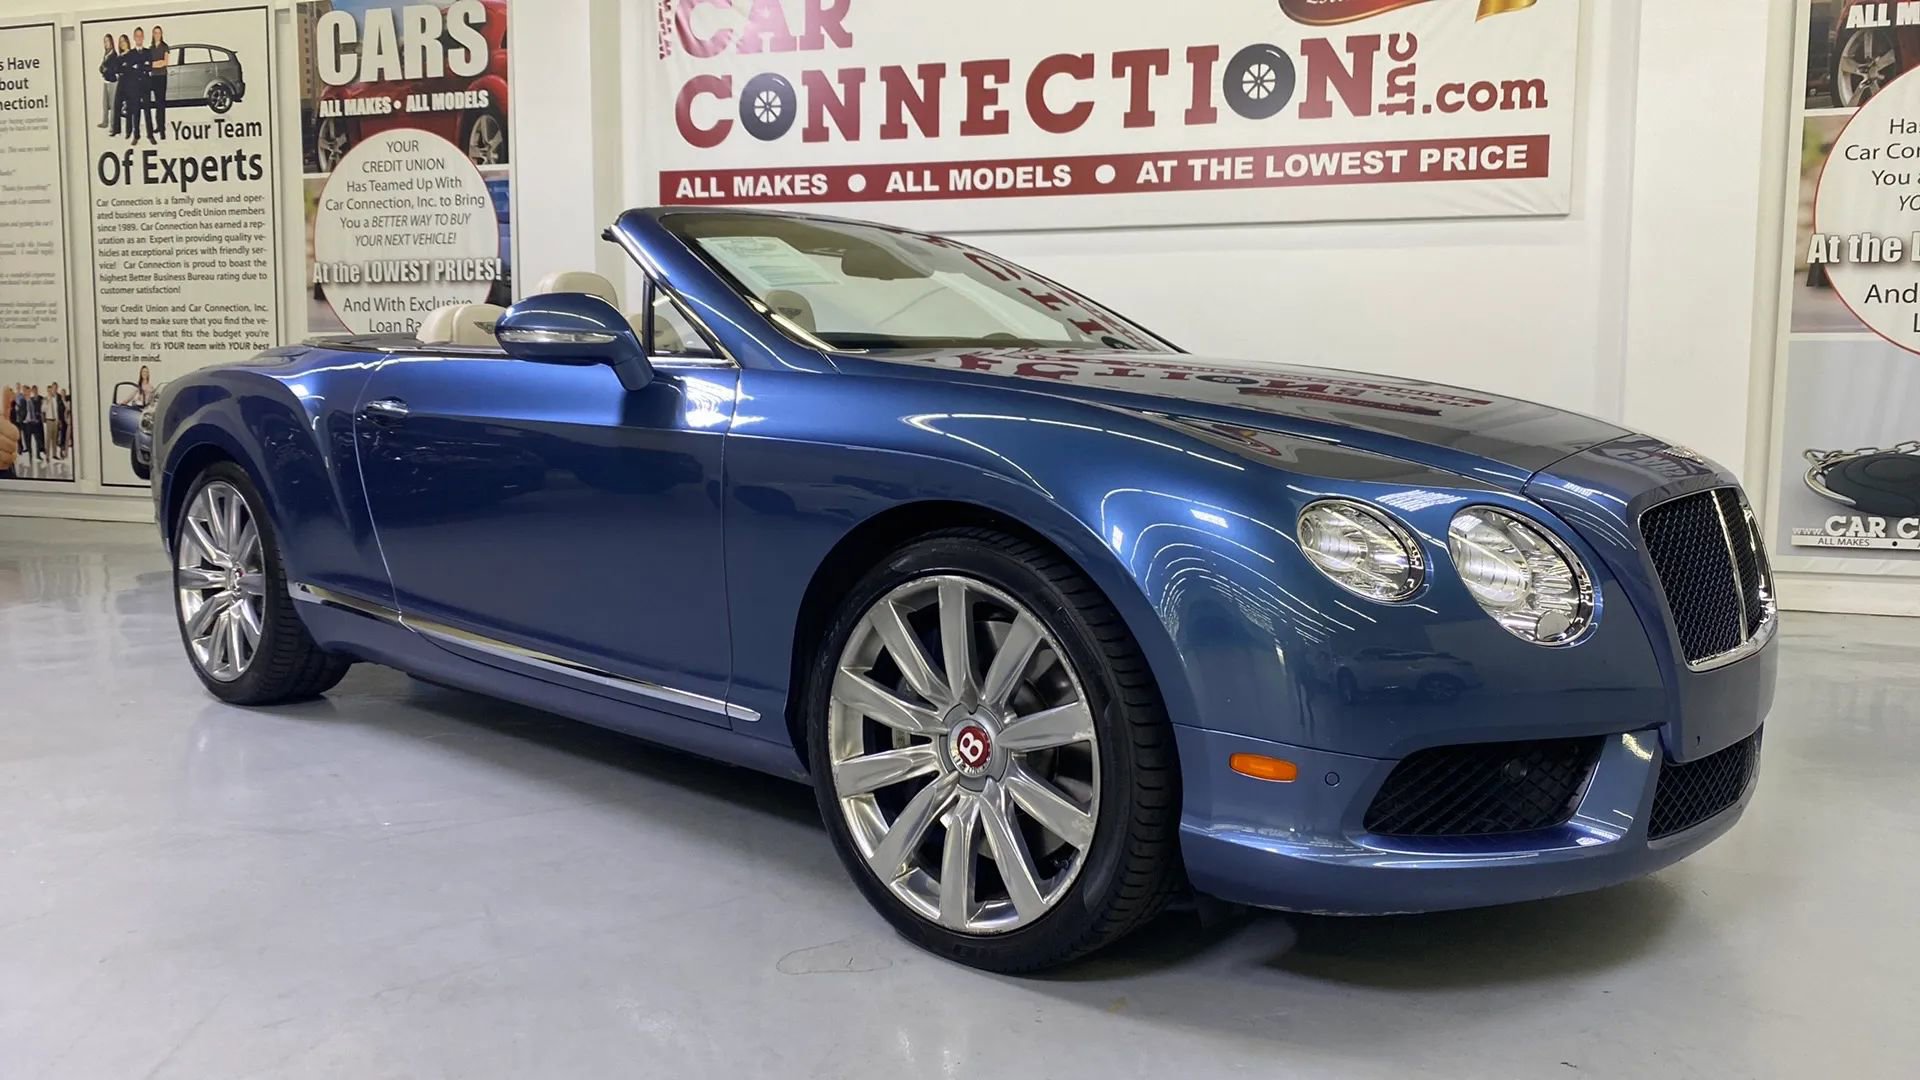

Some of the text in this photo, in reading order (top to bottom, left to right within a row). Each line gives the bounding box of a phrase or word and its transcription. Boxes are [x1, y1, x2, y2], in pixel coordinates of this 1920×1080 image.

[1846, 3, 1890, 28] ALL
[675, 0, 853, 58] CAR
[317, 0, 488, 86] CARS
[7, 57, 40, 70] Have
[1378, 32, 1418, 116] inc
[675, 33, 1381, 149] CONNECTION
[320, 89, 489, 118] ALL MAKES ALL MODELS
[171, 118, 262, 140] Your Team
[1889, 118, 1920, 134] Ha
[386, 140, 419, 153] YOUR
[1845, 144, 1880, 160] Car
[97, 148, 263, 192] Of Experts
[362, 158, 445, 173] CREDIT UNION
[676, 144, 1528, 199] ALL MAKES ALL MODELS AT THE LOWEST PRICE
[347, 176, 462, 192] Has Teamed Up With
[1872, 169, 1910, 186] You
[111, 198, 154, 207] Connection
[171, 195, 194, 206] family
[197, 195, 223, 204] owned
[225, 194, 241, 203] and
[325, 193, 485, 211] Car Connection, Inc. to Bring
[115, 211, 146, 219] business
[149, 210, 177, 219] serving
[178, 208, 202, 217] Credit
[203, 208, 227, 216] Union
[228, 207, 265, 216] members
[340, 213, 471, 229] You a BETTER WAY TO BUY
[97, 223, 116, 232] since
[140, 222, 153, 231] Car
[155, 222, 198, 231] Connection
[200, 221, 213, 229] has
[214, 220, 242, 229] earned
[149, 235, 174, 244] Expert
[185, 234, 222, 244] providing
[224, 233, 252, 243] quality
[355, 232, 457, 247] YOUR NEXT VEHICLE!
[131, 247, 174, 258] exceptional
[175, 247, 198, 257] prices
[200, 246, 218, 255] with
[219, 246, 249, 256] friendly
[1807, 231, 1902, 263] At the
[123, 261, 136, 269] Car
[138, 260, 181, 269] Connection
[192, 260, 216, 269] proud
[229, 259, 251, 267] boast
[253, 259, 267, 267] the
[312, 257, 502, 284] At the LOWEST PRICES!
[100, 272, 268, 284] highest Better Business Bureau rating due to
[1864, 282, 1918, 304] And
[101, 304, 118, 312] Your
[120, 304, 143, 312] Credit
[146, 304, 169, 312] Union
[171, 304, 186, 312] and
[188, 304, 202, 312] Car
[343, 298, 371, 313] And
[373, 297, 406, 312] With
[150, 316, 170, 325] make
[190, 316, 206, 325] that
[207, 318, 223, 327] you
[224, 316, 240, 325] find
[241, 316, 255, 325] the
[369, 317, 401, 333] Loan
[122, 331, 137, 339] you
[162, 329, 178, 337] that
[196, 329, 210, 337] the
[213, 329, 242, 339] budget
[102, 342, 131, 351] looking
[164, 342, 185, 350] YOUR
[209, 342, 226, 350] with
[228, 342, 251, 350] YOUR
[252, 342, 270, 350] best
[1825, 515, 1886, 538] CAR
[1817, 537, 1870, 547] ALL MAKES
[960, 732, 984, 763] B
